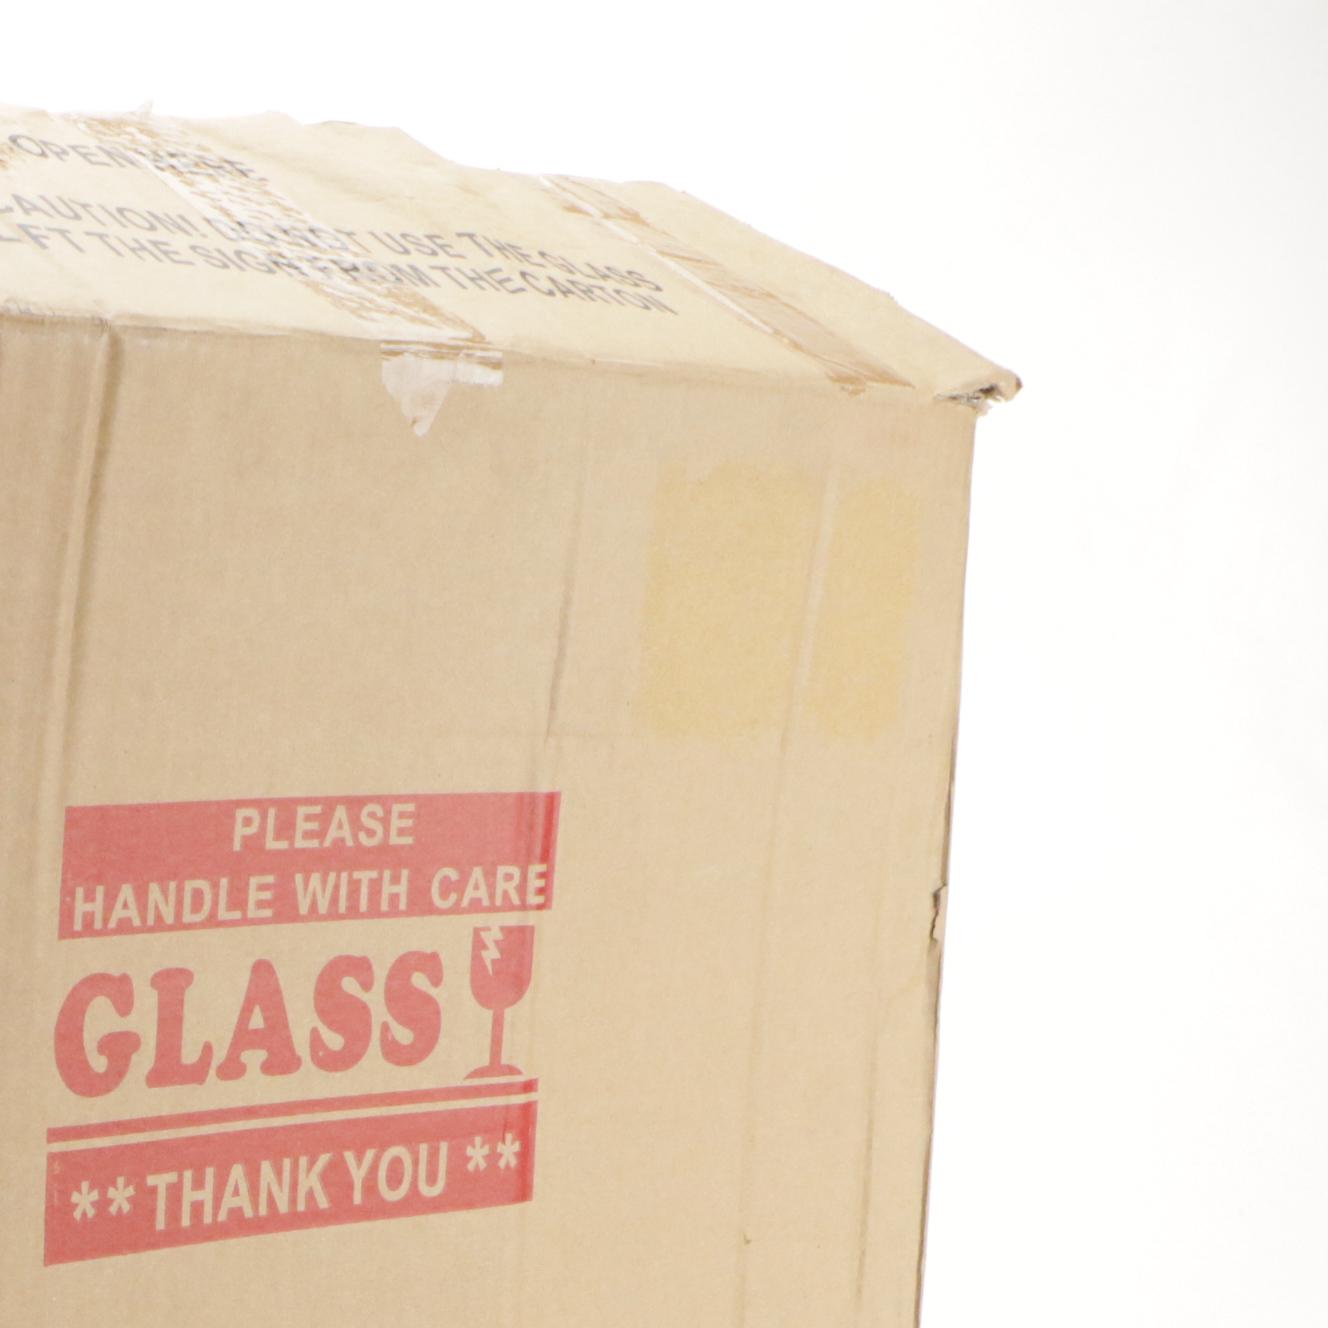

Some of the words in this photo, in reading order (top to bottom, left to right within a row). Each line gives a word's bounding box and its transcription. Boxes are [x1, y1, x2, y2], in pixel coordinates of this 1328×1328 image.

[83, 230, 196, 266] THE
[428, 263, 527, 295] THE
[518, 269, 680, 316] CARTON
[369, 231, 467, 260] USE
[455, 231, 547, 269] THE
[231, 801, 417, 852] PLEASE
[72, 873, 276, 933] HANDLE
[294, 867, 410, 916] WITH
[430, 863, 549, 910] CARE
[53, 949, 444, 1099] GLASS
[342, 1140, 449, 1207] YOU
